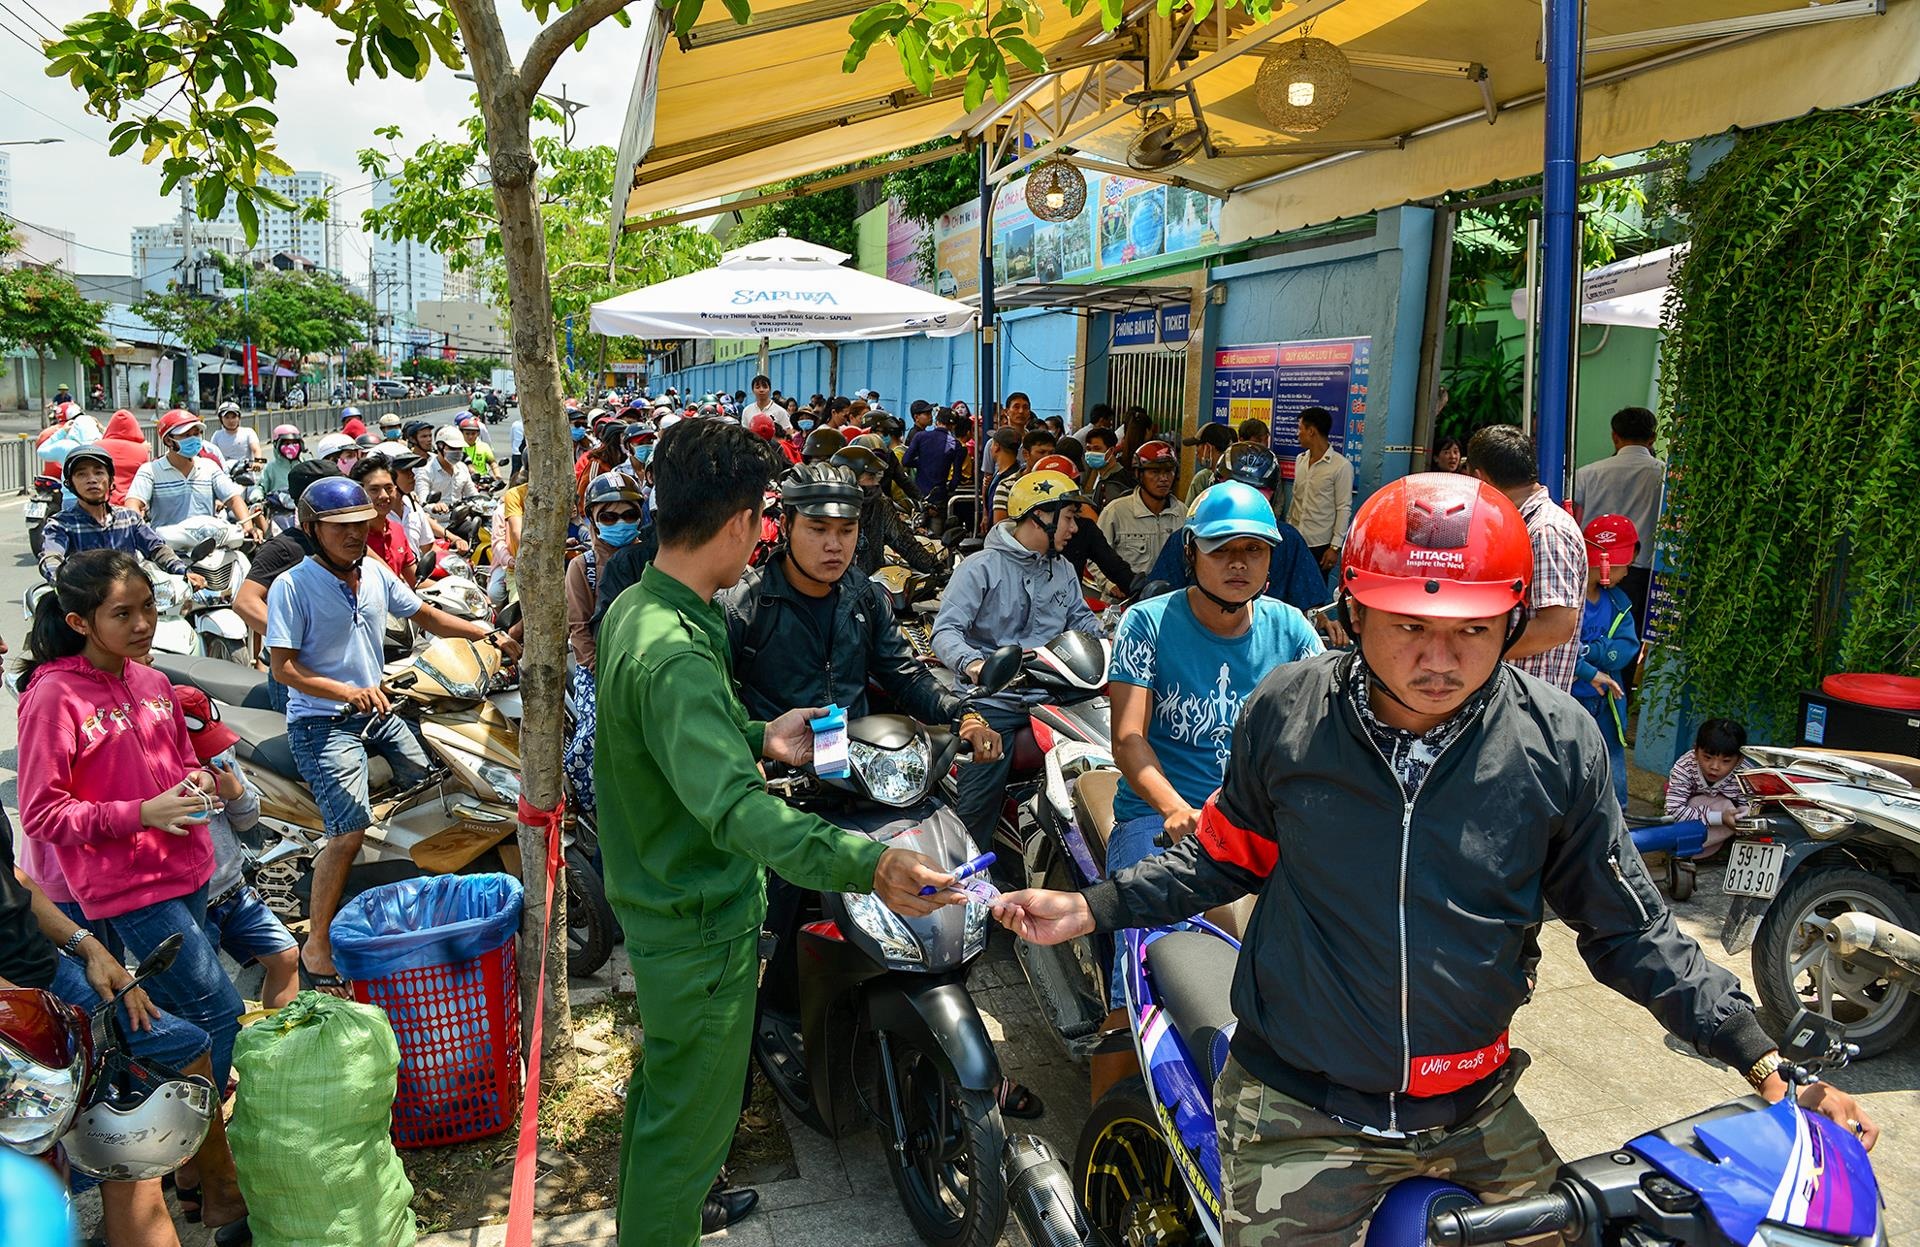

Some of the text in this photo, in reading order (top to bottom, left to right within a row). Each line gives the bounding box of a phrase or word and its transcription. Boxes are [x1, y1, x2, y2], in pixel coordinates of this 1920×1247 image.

[731, 289, 839, 305] SAPUWA
[1164, 313, 1187, 332] TICKET
[1406, 559, 1465, 570] Inspire the Next
[1409, 550, 1463, 563] HITACHI
[464, 822, 501, 834] HONDA
[1737, 845, 1775, 869] 59-T1
[1727, 868, 1775, 893] 813.90
[1188, 1161, 1222, 1221] SHAR
